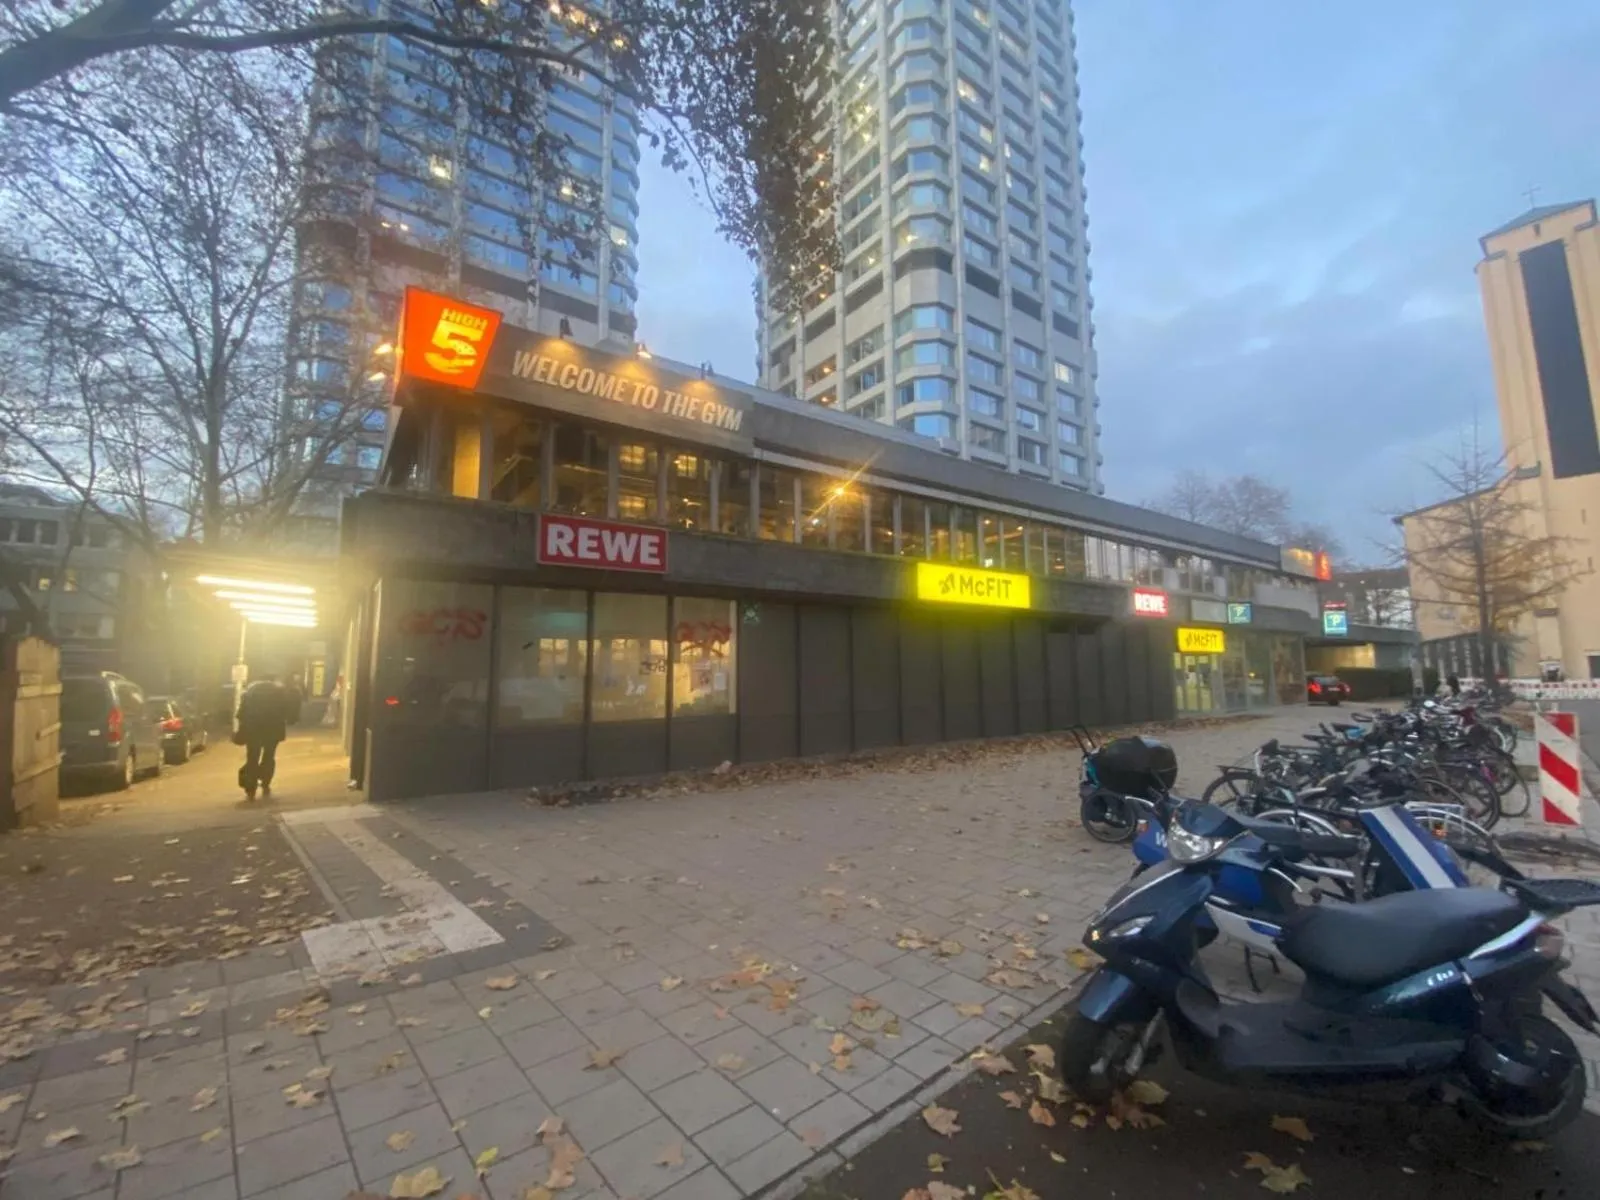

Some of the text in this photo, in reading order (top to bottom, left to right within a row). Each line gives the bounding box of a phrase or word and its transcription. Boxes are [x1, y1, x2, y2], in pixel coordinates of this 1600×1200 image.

[441, 307, 488, 331] HIGH
[424, 319, 484, 375] 5
[511, 350, 744, 432] WELCOME TO THE GYM
[546, 523, 661, 566] REWE
[959, 574, 1012, 600] McFIT
[1135, 592, 1167, 614] REWE
